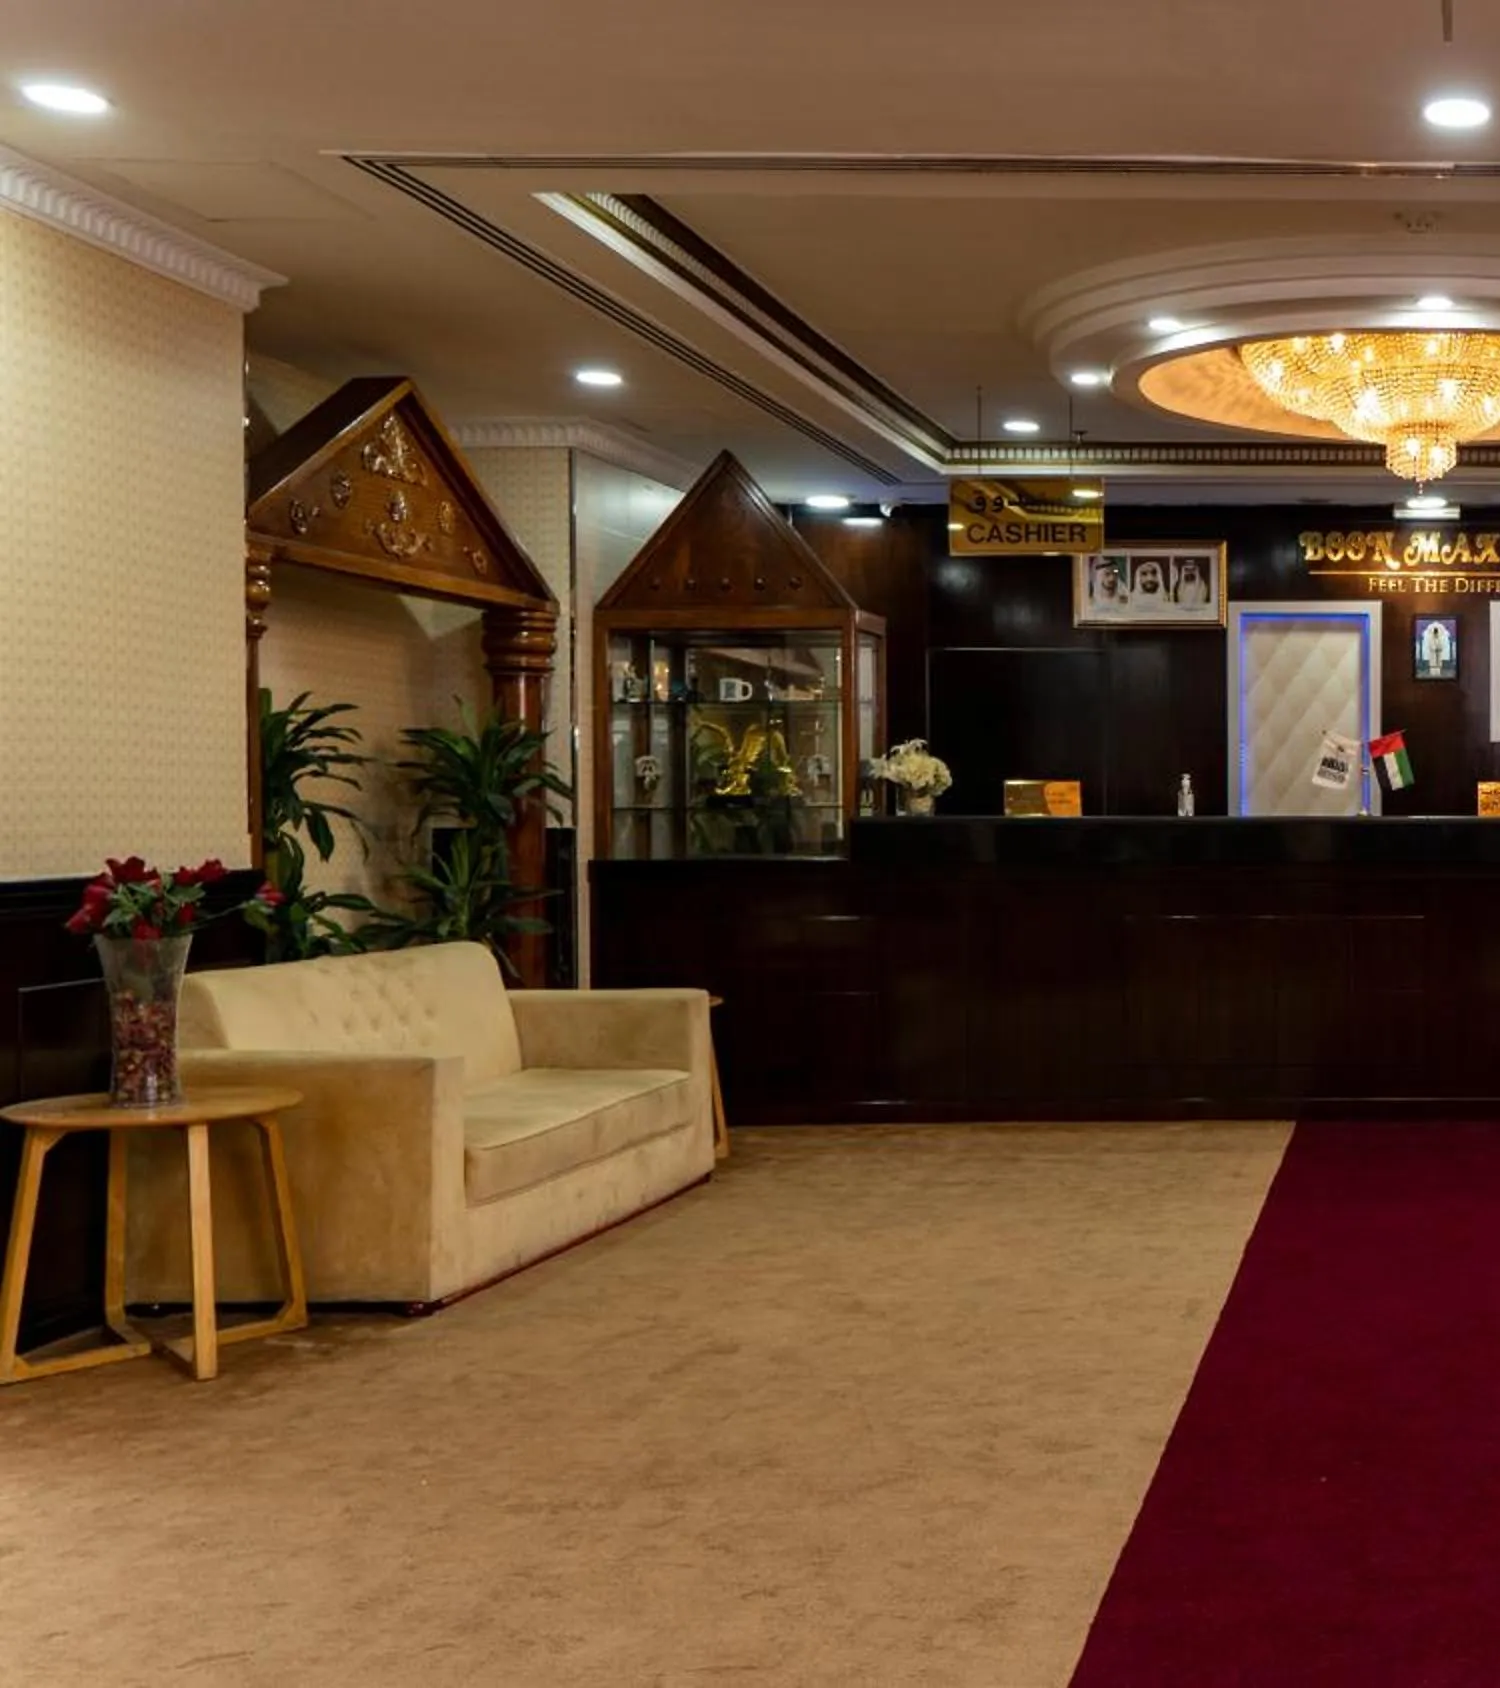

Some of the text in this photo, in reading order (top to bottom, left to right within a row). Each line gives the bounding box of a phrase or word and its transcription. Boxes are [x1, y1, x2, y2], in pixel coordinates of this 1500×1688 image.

[966, 522, 1087, 545] CASHIER
[1404, 530, 1500, 567] MAX
[1368, 577, 1406, 593] FEEL
[1411, 577, 1449, 594] THE
